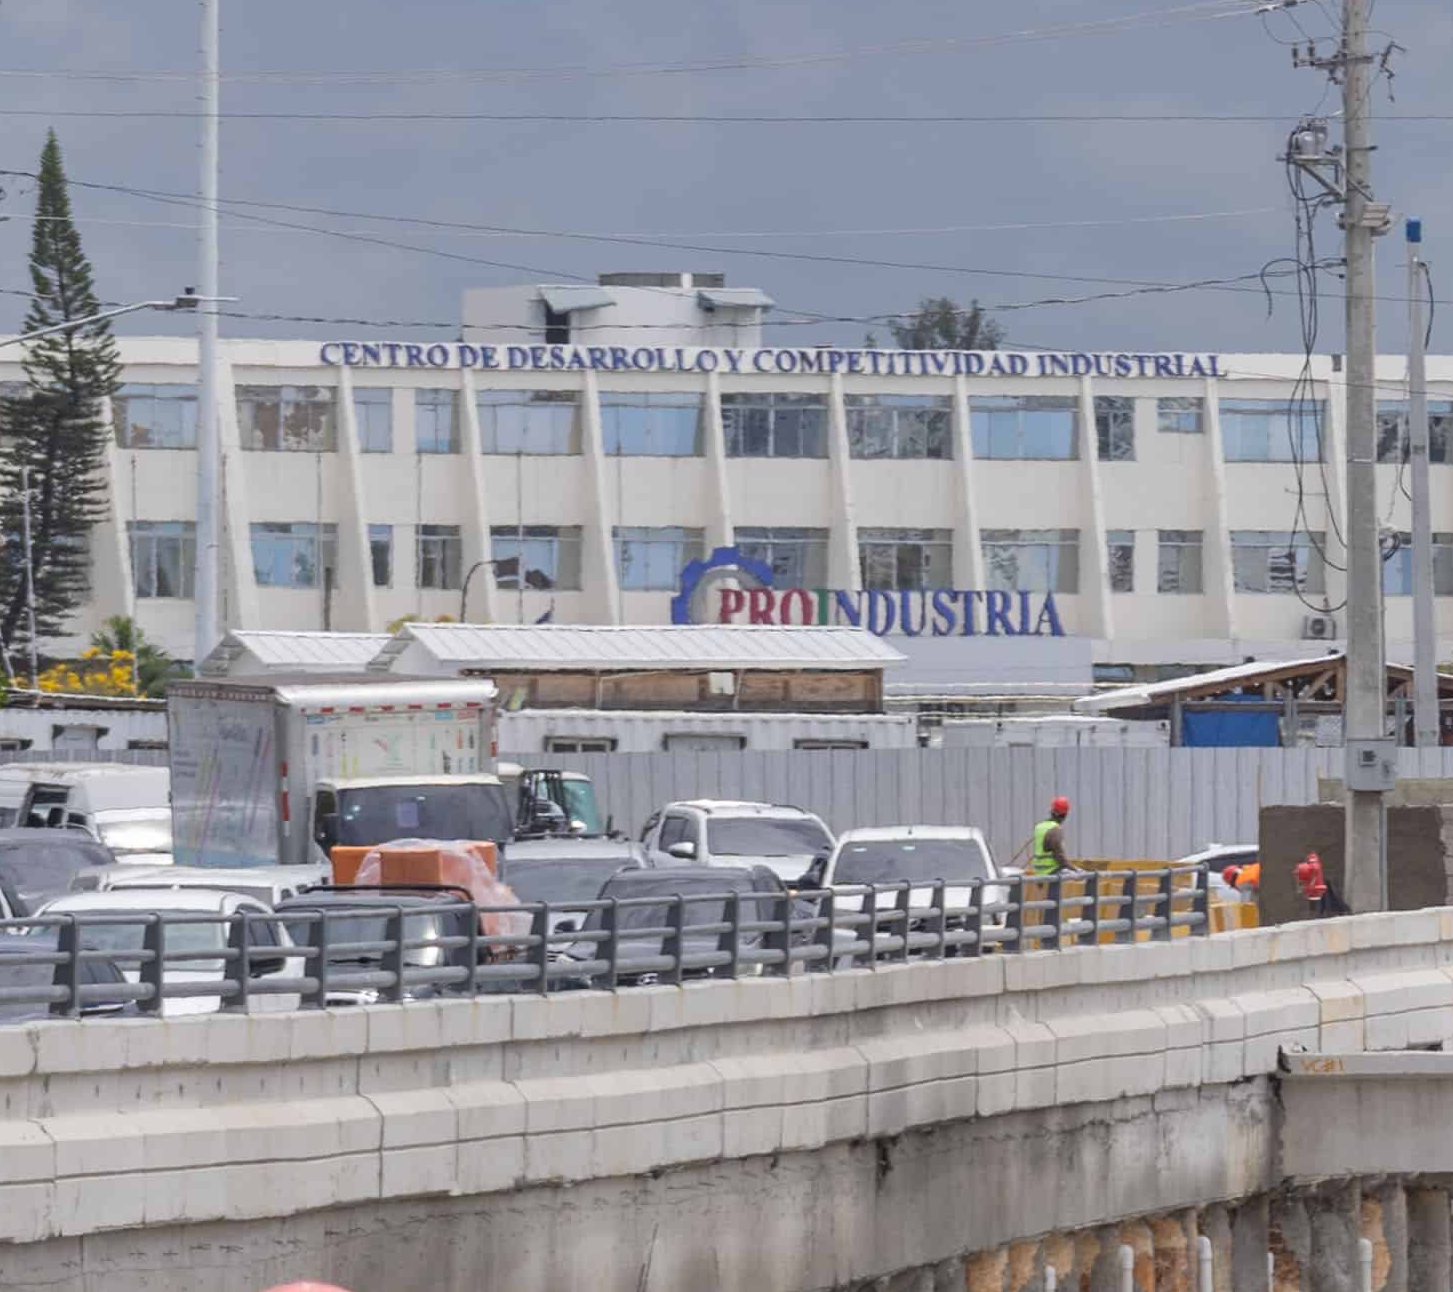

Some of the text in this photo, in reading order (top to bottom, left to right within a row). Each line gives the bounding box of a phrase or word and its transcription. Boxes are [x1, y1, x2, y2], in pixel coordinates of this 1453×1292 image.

[319, 342, 1228, 378] CENTRO DE DESARROLLO Y COMPETITIVIDAD INDUSTRIAL
[717, 587, 1067, 638] PROINDUSTRIA
